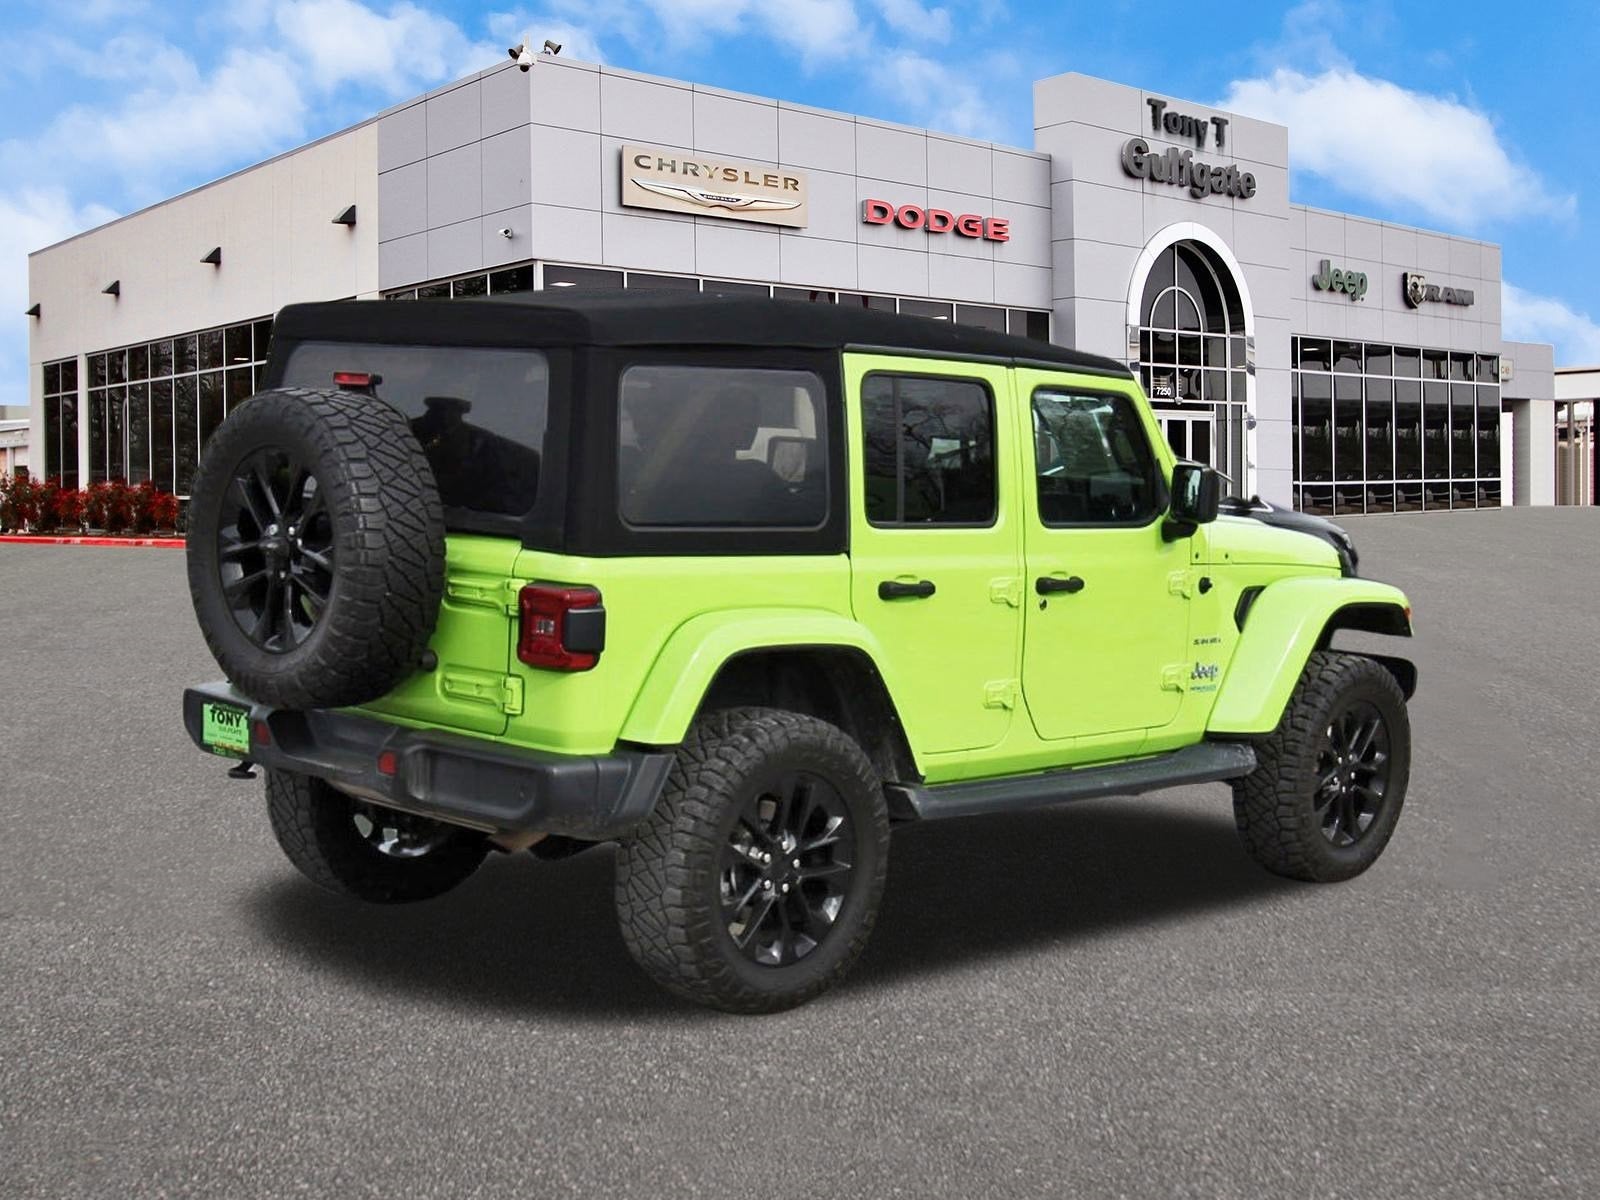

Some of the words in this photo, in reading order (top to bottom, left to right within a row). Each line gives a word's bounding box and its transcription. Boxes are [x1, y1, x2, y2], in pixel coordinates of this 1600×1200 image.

[1146, 98, 1208, 147] Tony
[1210, 116, 1229, 147] T
[634, 155, 800, 191] CHRYSLER
[1121, 138, 1256, 199] Gulfgate
[862, 199, 1009, 242] DODGE
[1312, 259, 1368, 302] Jeep
[1425, 284, 1475, 306] RAM
[1156, 387, 1171, 396] 7250
[210, 709, 241, 727] TONY
